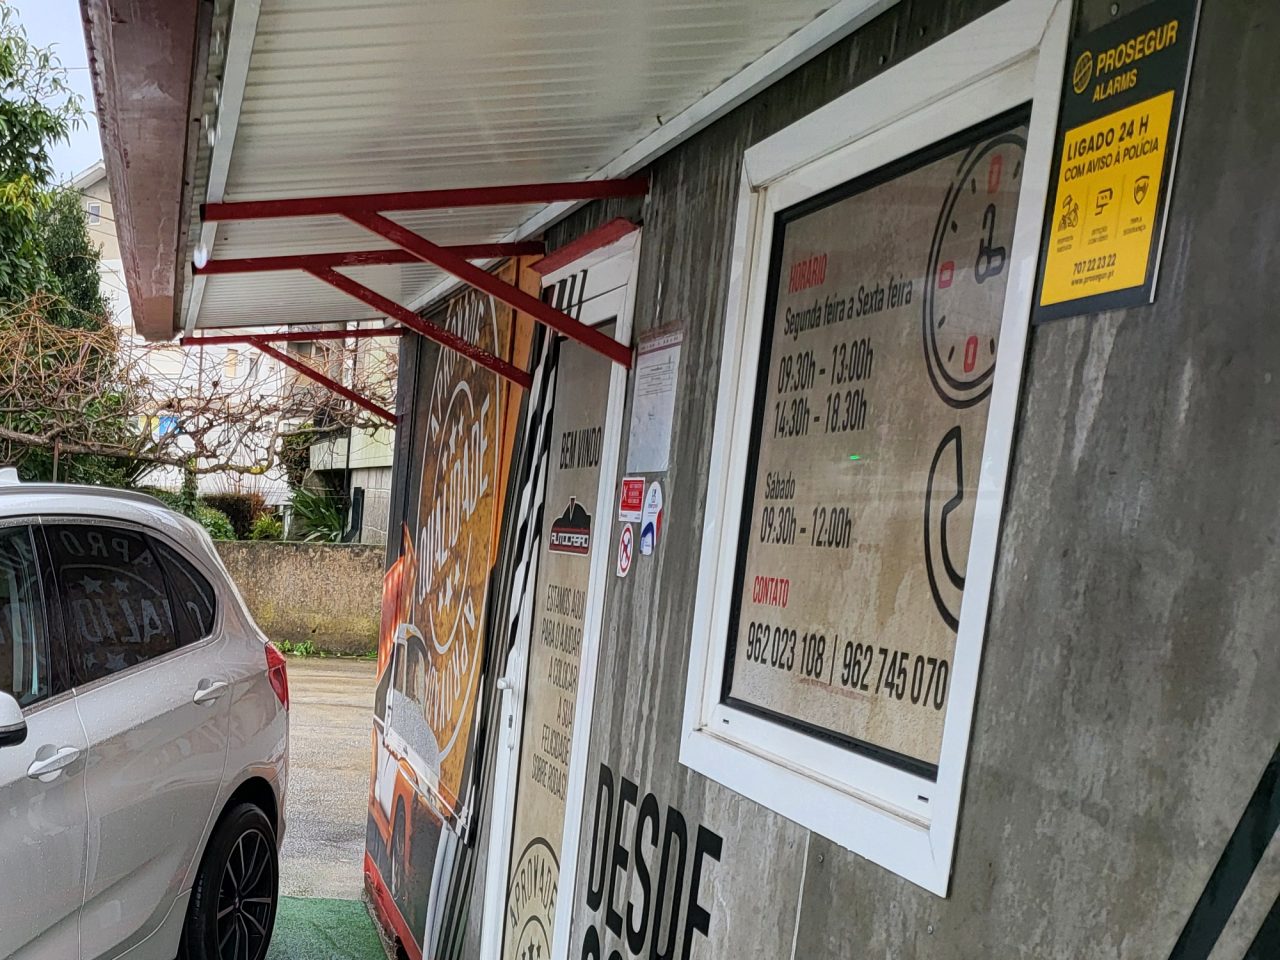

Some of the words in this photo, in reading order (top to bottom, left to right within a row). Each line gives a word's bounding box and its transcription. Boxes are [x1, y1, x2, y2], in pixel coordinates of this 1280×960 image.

[1096, 20, 1179, 77] PROSEGUR
[1092, 68, 1138, 103] ALARMS
[1064, 163, 1086, 182] COM
[1087, 153, 1113, 174] AVISO
[1122, 136, 1159, 163] POLÍCIA
[1067, 128, 1115, 162] LIGADO
[1119, 119, 1135, 142] 24
[1139, 114, 1149, 136] H
[788, 252, 828, 295] HORÁRIO
[1073, 260, 1087, 276] 707
[784, 300, 821, 341] Segunda
[823, 293, 846, 326] feira
[846, 296, 855, 319] a
[856, 283, 885, 317] Sexta
[886, 273, 914, 309] feira
[777, 350, 816, 394] 09:30h
[830, 336, 874, 386] 13:00h
[773, 397, 810, 439] 14:30h
[560, 429, 578, 470] BEM
[577, 426, 602, 468] VINDO
[418, 392, 491, 606] QUALIDADE
[764, 471, 796, 501] Sábado
[760, 505, 797, 546] 09:30h
[811, 506, 853, 549] 12:00h
[546, 584, 571, 617] ESTAMOS
[752, 575, 790, 609] CONTATO
[541, 617, 555, 648] PARA
[548, 655, 554, 684] A
[552, 657, 578, 694] COLOCAR
[746, 621, 771, 665] 962
[771, 626, 797, 672] 023
[799, 631, 827, 680] 108
[841, 641, 874, 692] 962
[874, 647, 910, 701] 745
[910, 654, 950, 711] 070
[562, 698, 574, 730] SUA
[532, 753, 549, 788] SOBRE
